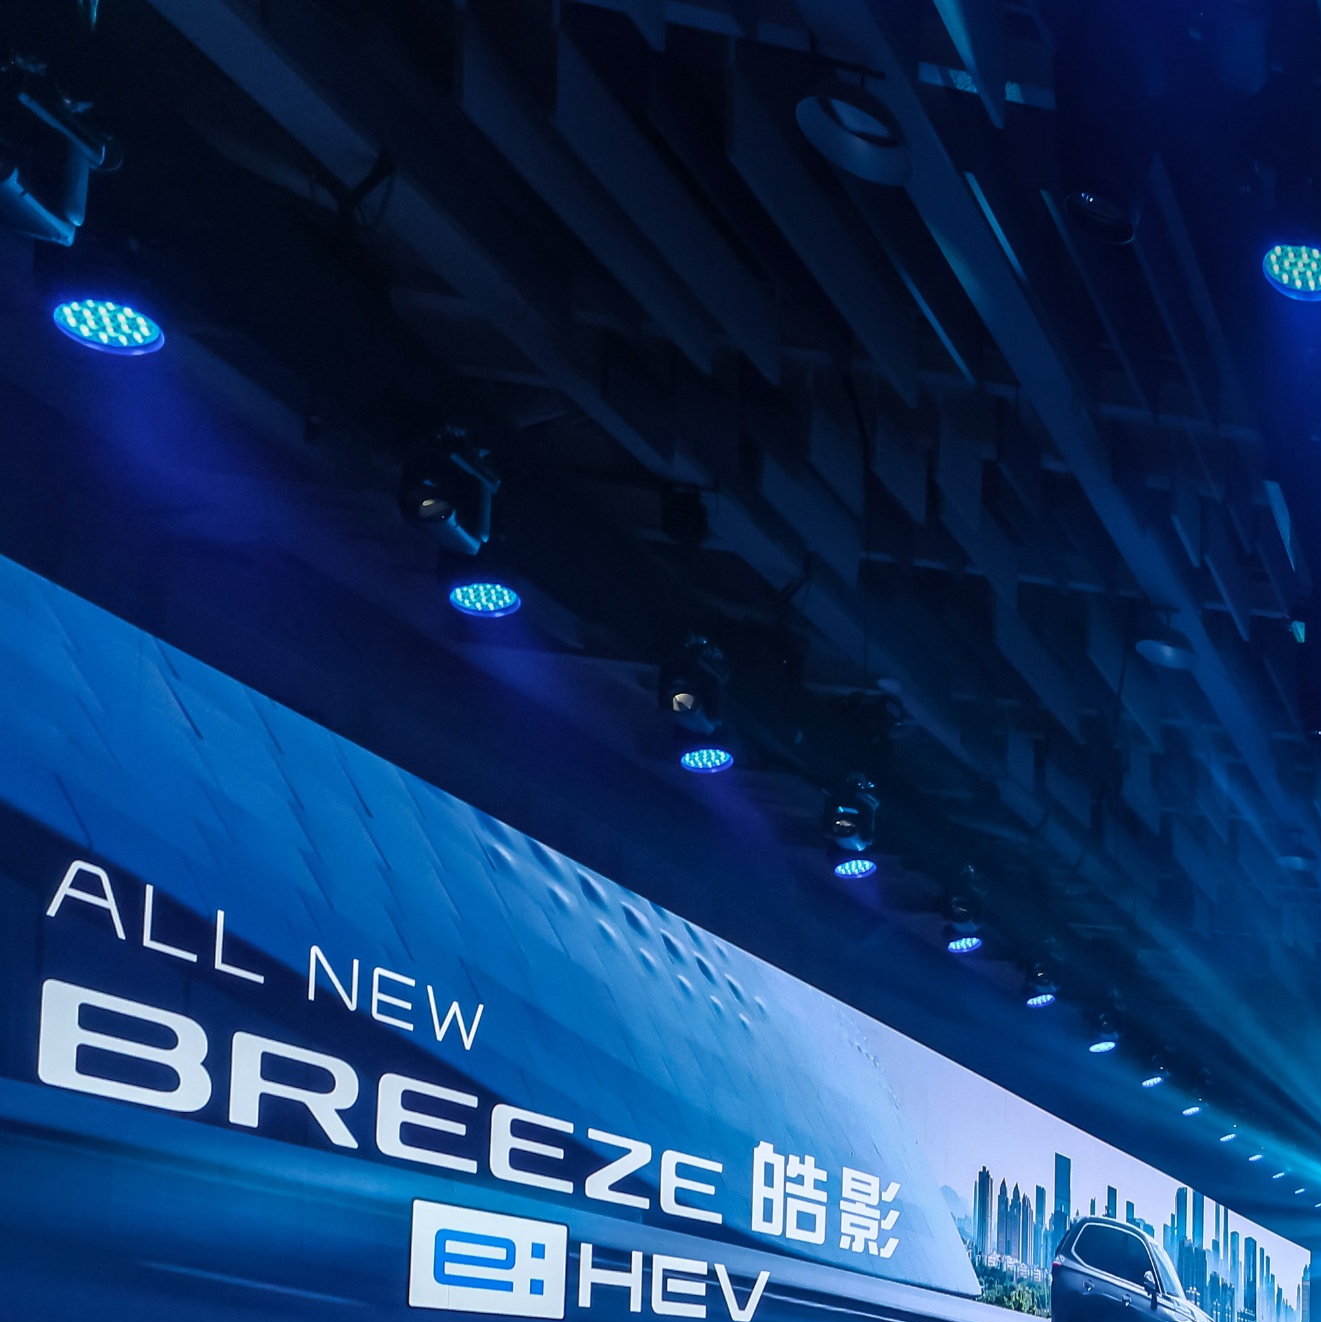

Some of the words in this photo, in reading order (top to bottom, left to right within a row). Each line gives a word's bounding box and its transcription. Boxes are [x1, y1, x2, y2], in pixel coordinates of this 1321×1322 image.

[47, 860, 265, 984] ALL
[308, 945, 484, 1050] NEW
[38, 978, 723, 1226] BREEZE
[751, 1140, 901, 1259] 皓影
